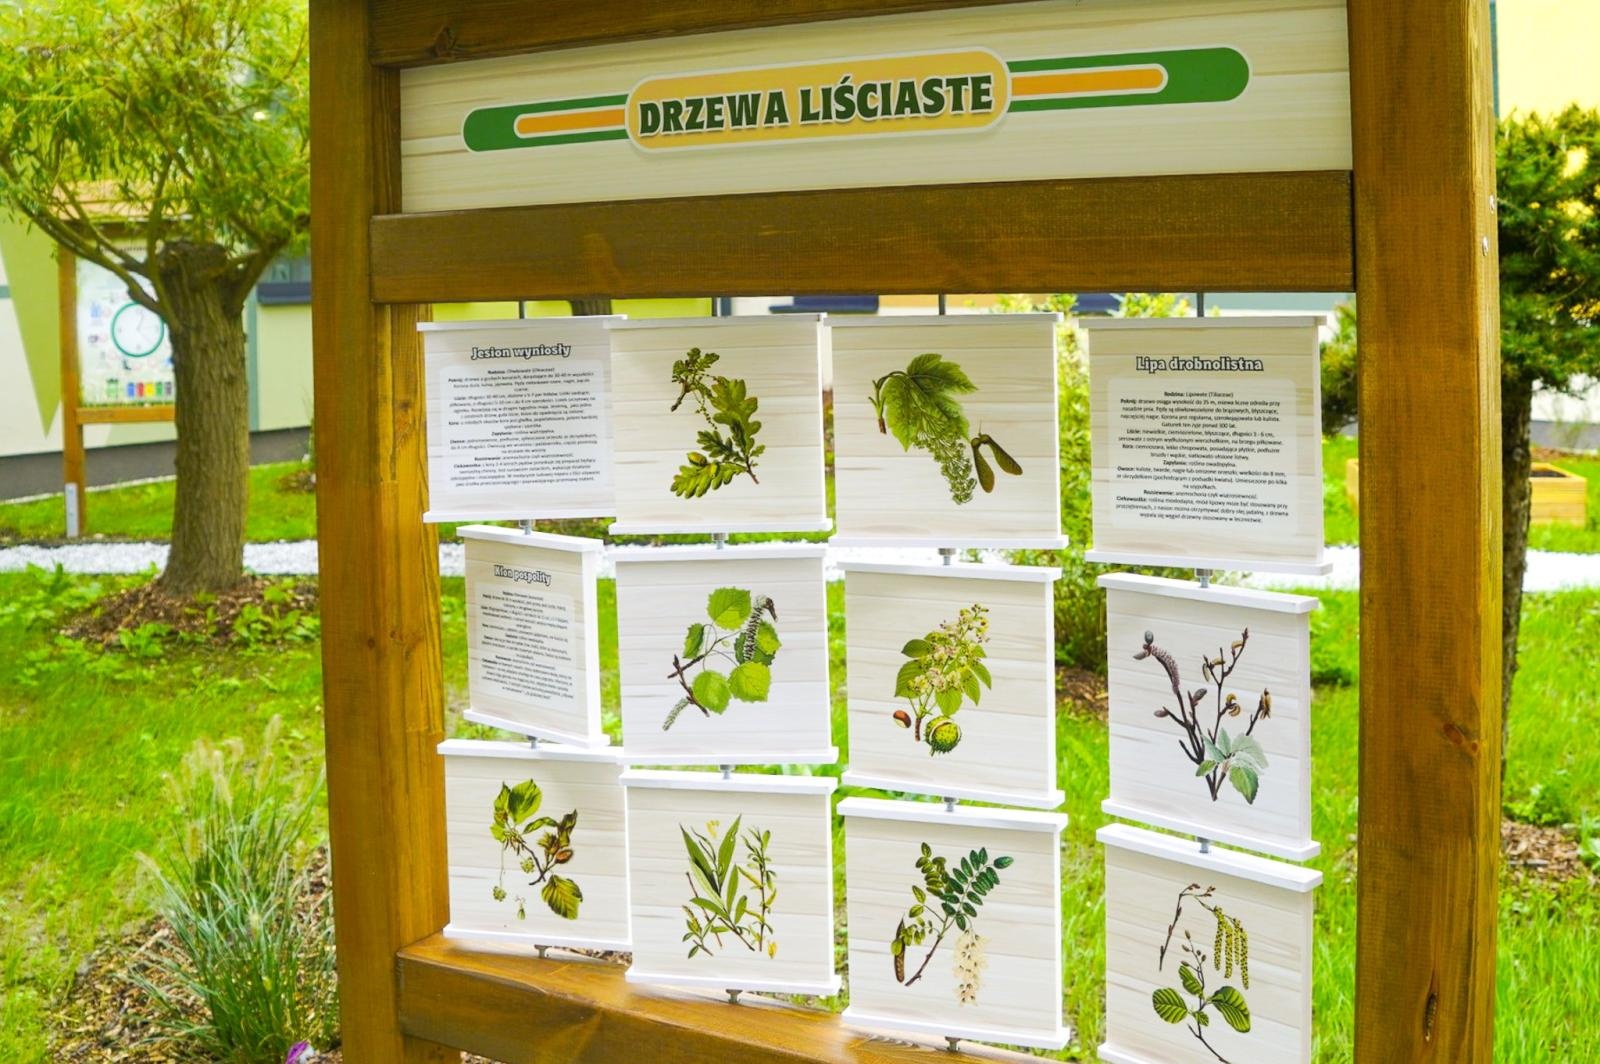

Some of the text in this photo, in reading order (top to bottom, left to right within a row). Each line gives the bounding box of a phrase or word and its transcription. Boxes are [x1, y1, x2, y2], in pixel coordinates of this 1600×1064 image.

[639, 75, 993, 134] DRZEWA LIŚCIASTE
[471, 343, 571, 360] Jesion wyniosły
[1136, 356, 1264, 374] Lipa drobnolistna
[494, 564, 551, 586] Klon pospolity
